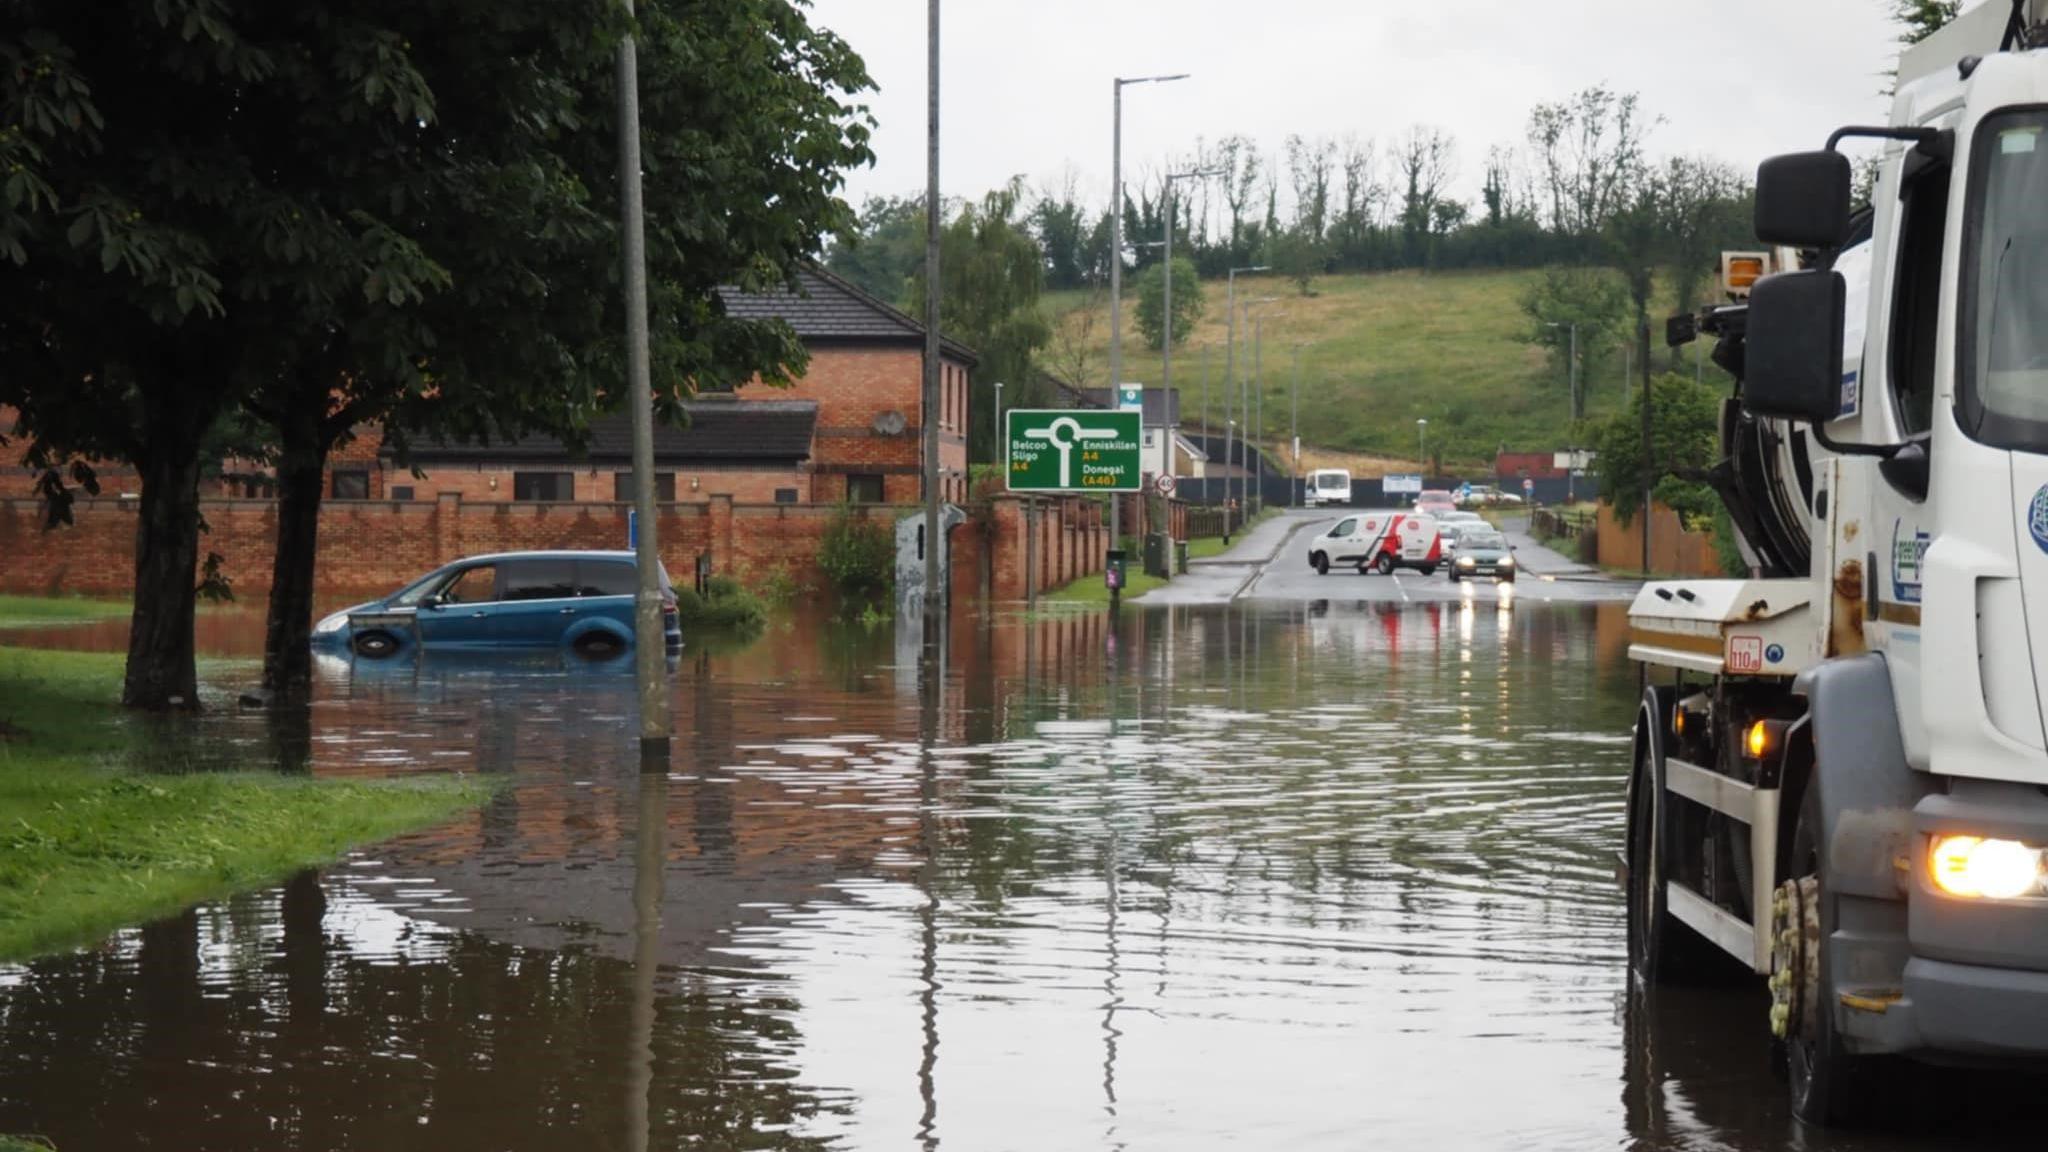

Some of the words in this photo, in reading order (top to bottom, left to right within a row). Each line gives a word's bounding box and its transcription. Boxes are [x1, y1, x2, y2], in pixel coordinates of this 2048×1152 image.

[1012, 440, 1047, 449] Belcoo
[1083, 440, 1137, 449] Enniskillen
[1012, 451, 1037, 461] Sligo
[1083, 452, 1098, 460] A4
[1012, 462, 1027, 470] A4
[1083, 464, 1124, 475] Donegal
